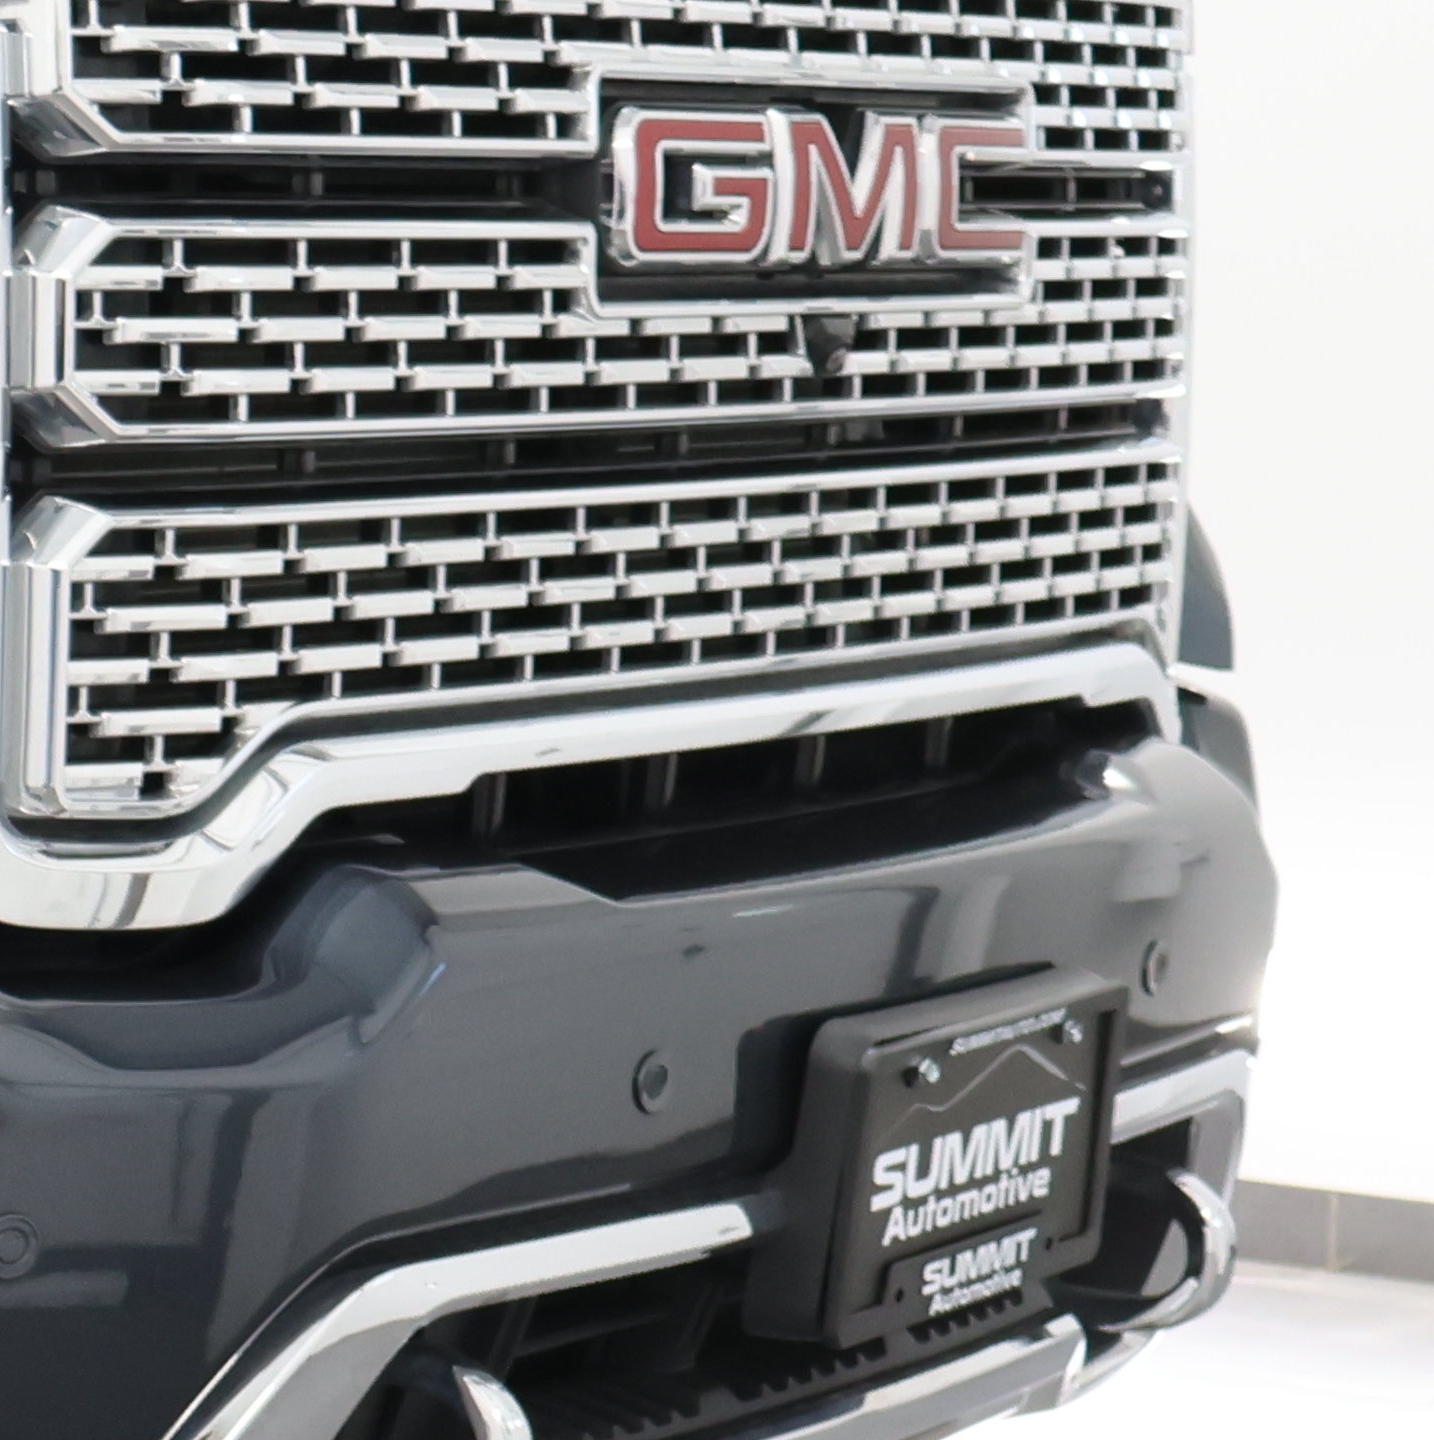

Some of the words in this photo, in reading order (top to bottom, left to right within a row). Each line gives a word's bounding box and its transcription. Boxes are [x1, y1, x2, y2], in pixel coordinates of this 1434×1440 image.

[610, 106, 1027, 266] GMC
[870, 1096, 1081, 1212] SUMMIT
[881, 1166, 1052, 1246] Automotive
[921, 1227, 1038, 1296] SUMMIT
